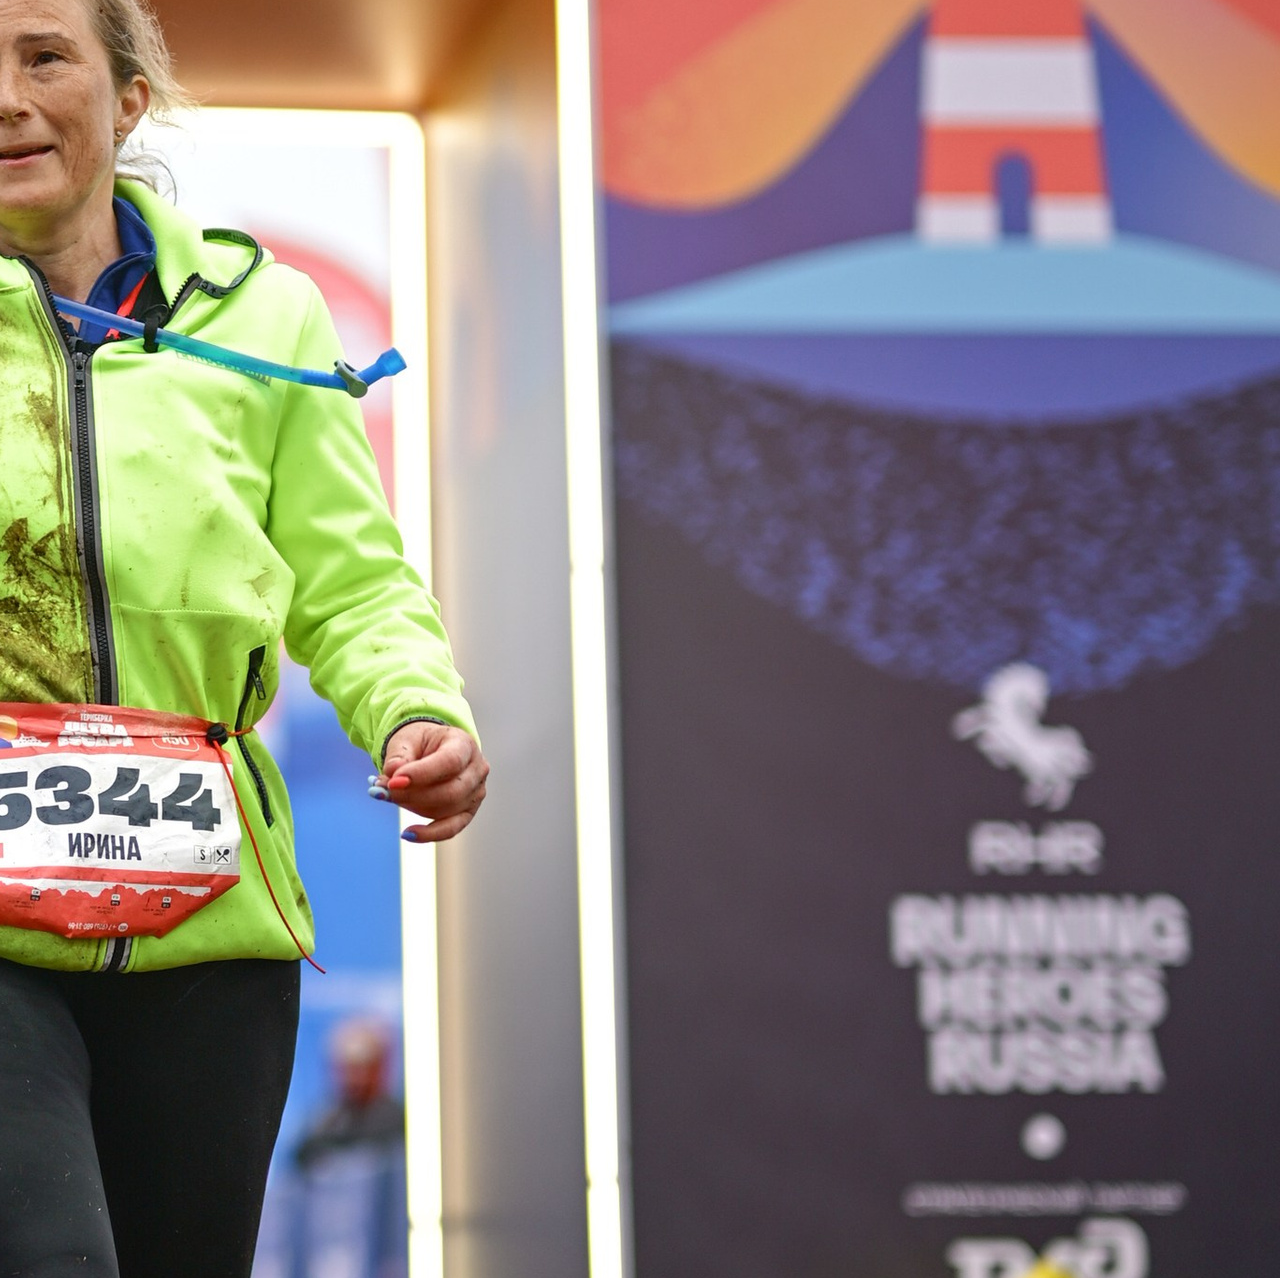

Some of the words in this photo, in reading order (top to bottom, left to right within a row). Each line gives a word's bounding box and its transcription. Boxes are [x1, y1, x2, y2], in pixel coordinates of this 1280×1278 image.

[65, 721, 129, 736] ULTRA
[68, 833, 142, 861] ИРИНА
[200, 849, 206, 861] S
[890, 894, 1190, 966] RUNNING
[918, 965, 1168, 1028] HEROES
[928, 1028, 1164, 1092] RUSSIA
